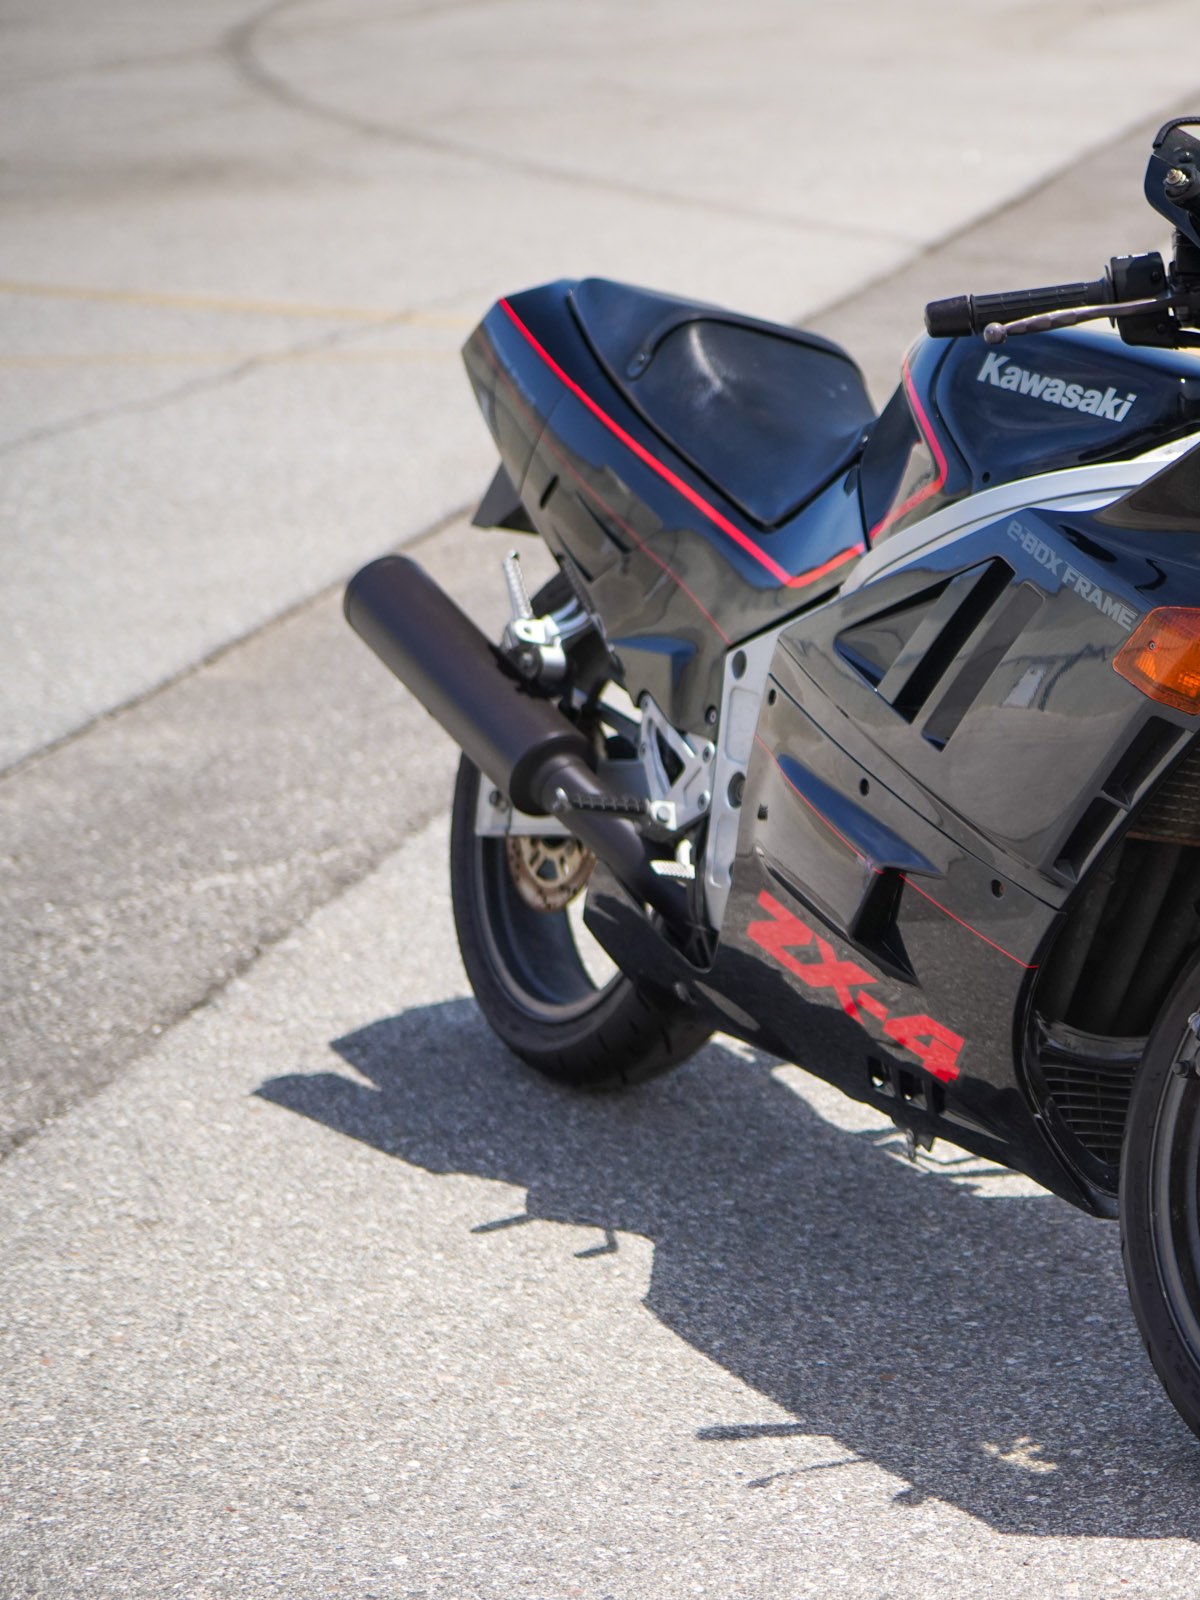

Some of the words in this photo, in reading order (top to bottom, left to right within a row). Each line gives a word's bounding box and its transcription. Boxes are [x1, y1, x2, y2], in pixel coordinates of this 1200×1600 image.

[976, 352, 1138, 423] Kawasaki
[1062, 563, 1138, 632] FRAME
[747, 889, 965, 1084] ZX-4
